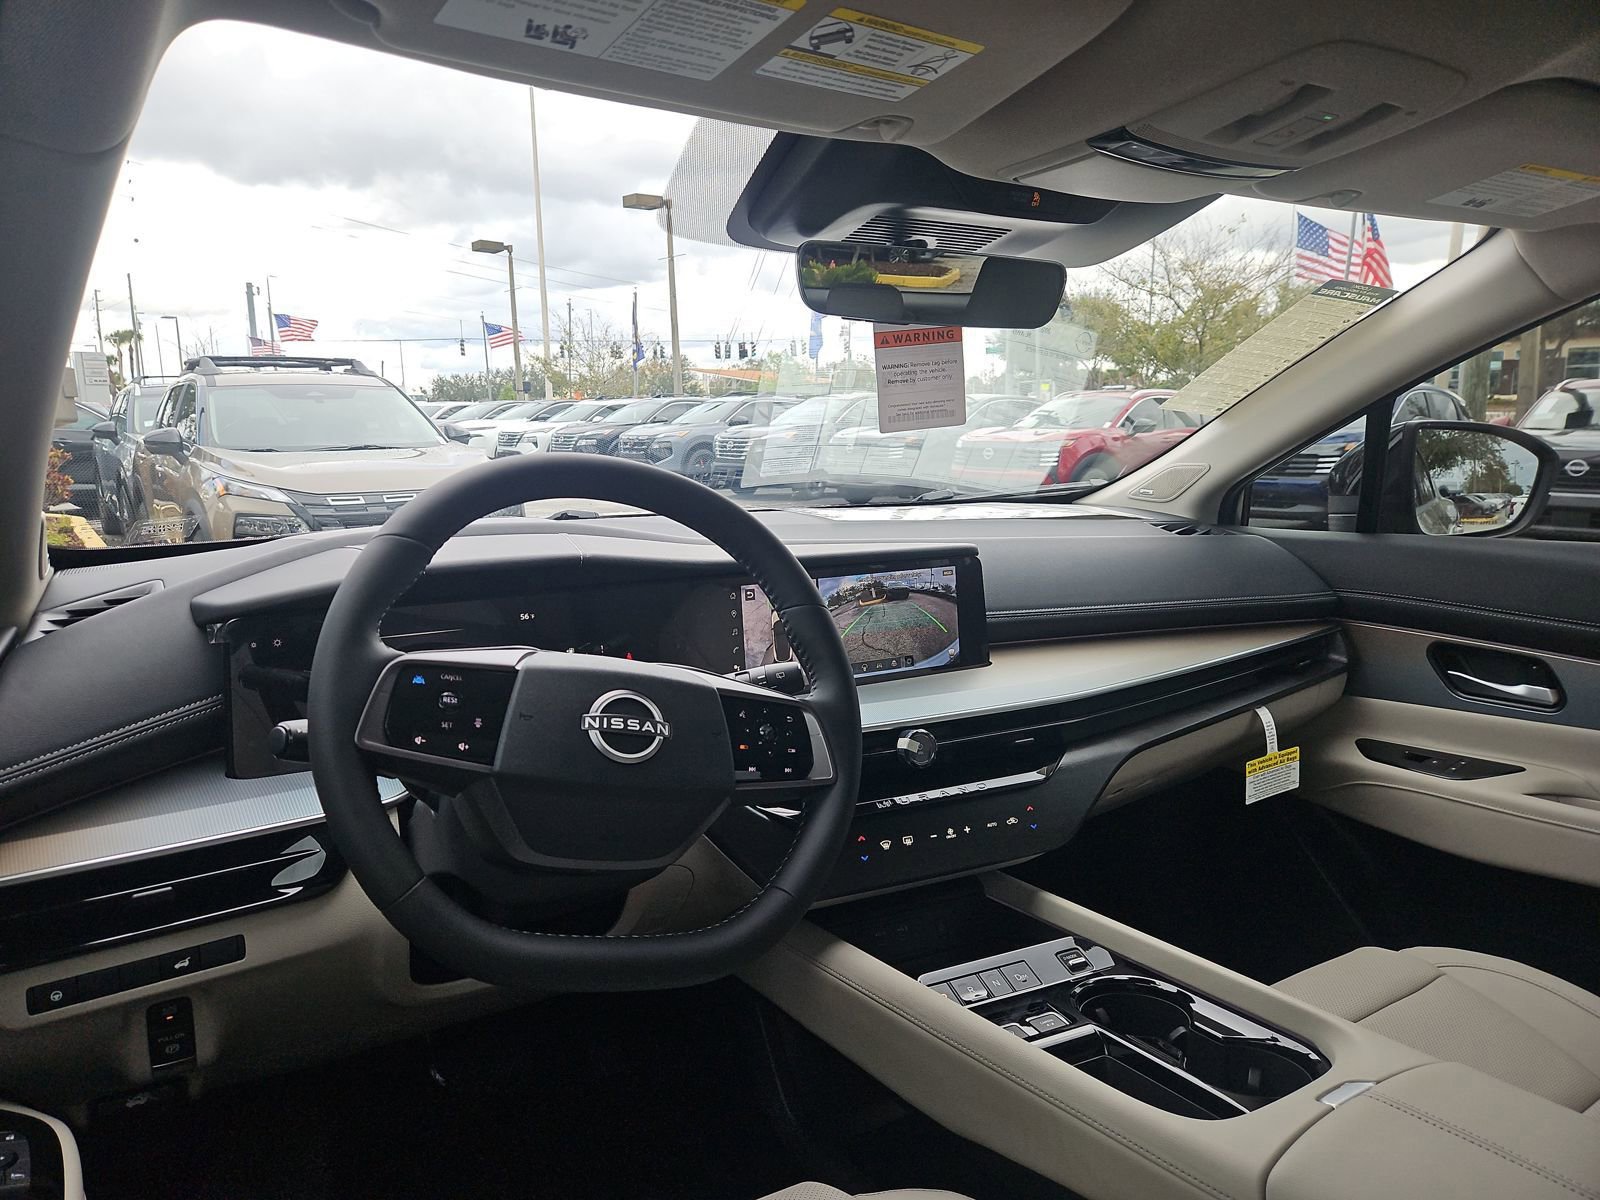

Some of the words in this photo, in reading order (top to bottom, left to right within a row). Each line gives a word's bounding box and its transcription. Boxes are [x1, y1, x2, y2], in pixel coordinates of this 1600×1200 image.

[893, 330, 955, 343] WARNING
[882, 363, 910, 371] WARNING:
[894, 369, 918, 378] operating
[887, 377, 910, 385] Remove
[917, 375, 940, 383] customer
[584, 714, 669, 737] NISSAN
